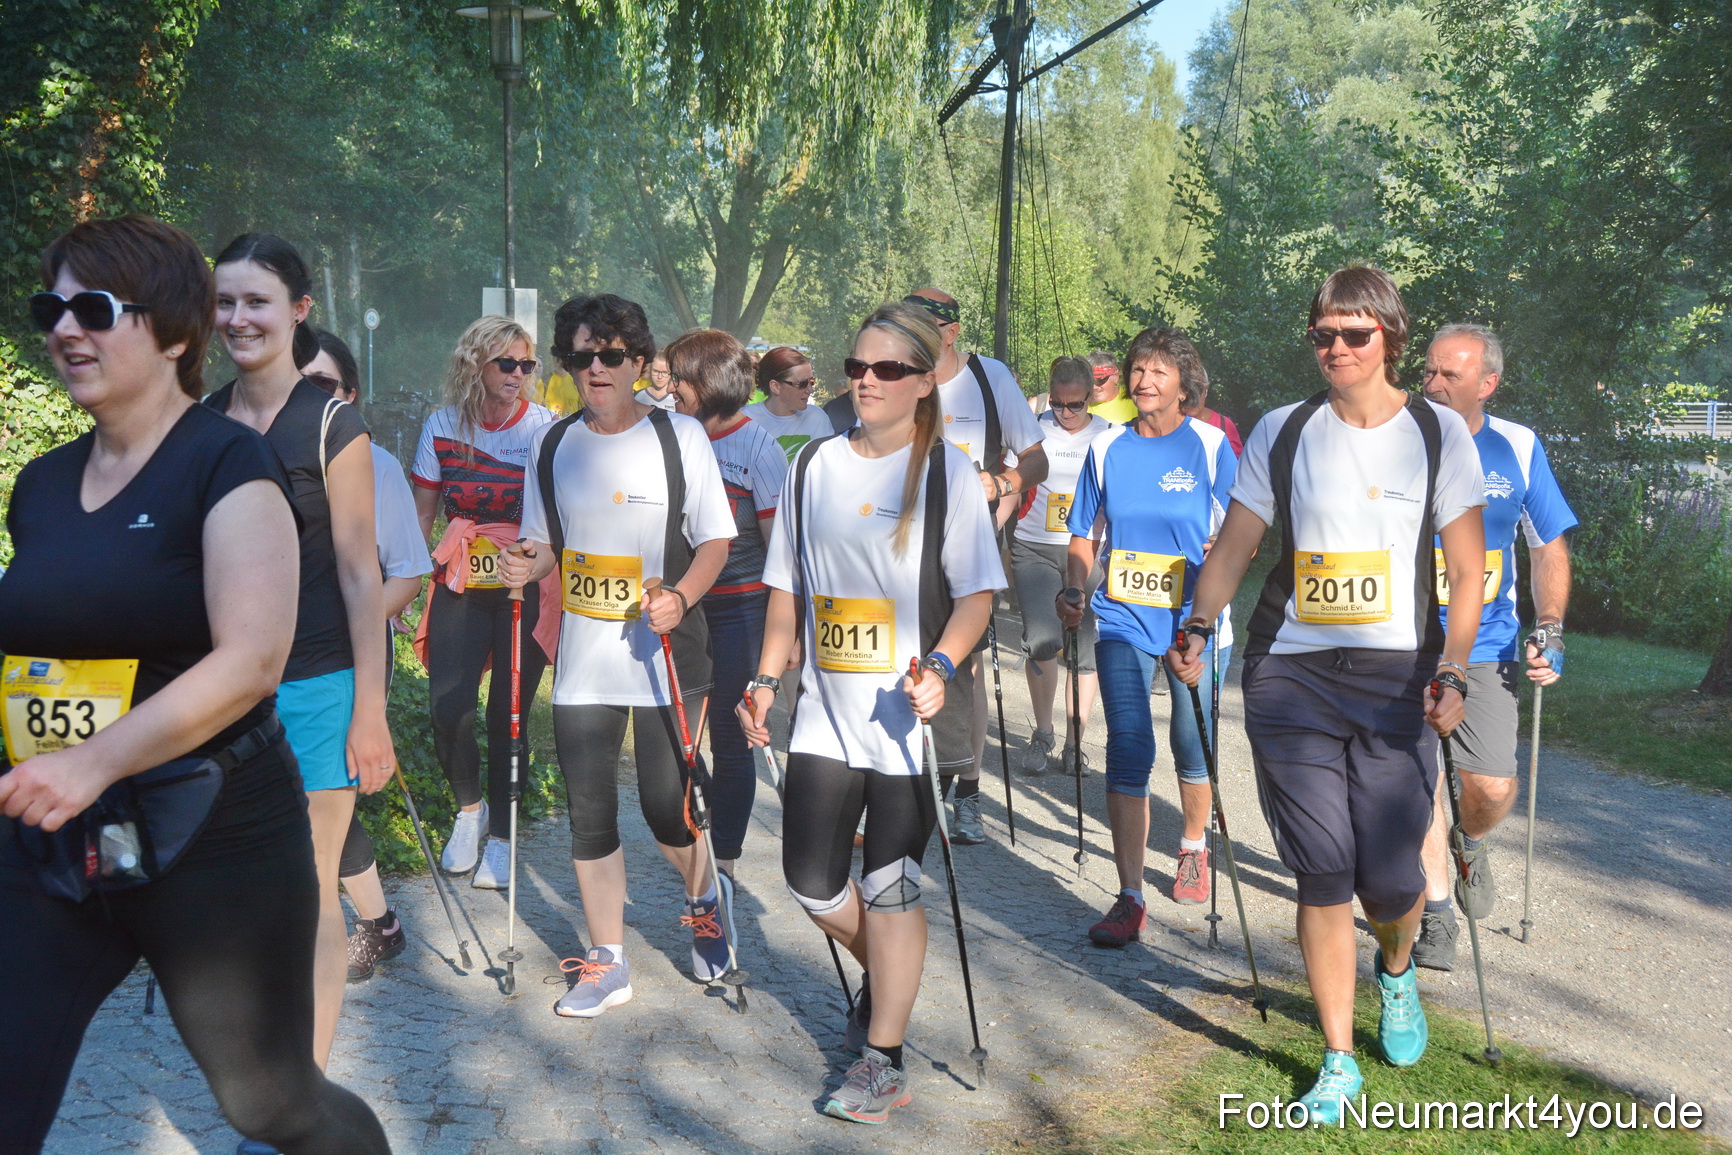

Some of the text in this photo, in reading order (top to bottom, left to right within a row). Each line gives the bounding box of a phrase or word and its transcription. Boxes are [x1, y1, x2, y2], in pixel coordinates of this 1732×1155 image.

[499, 447, 528, 456] NEUMAR
[1055, 449, 1086, 460] intellito
[469, 554, 497, 574] 90
[570, 573, 630, 602] 2013
[1118, 569, 1174, 593] 1966
[1438, 569, 1494, 589] 17
[1305, 576, 1378, 604] 2010
[578, 598, 620, 609] Krauser Olga
[1320, 604, 1349, 612] Schmid
[820, 622, 878, 651] 2011
[825, 650, 873, 659] Weber Kristina
[27, 697, 96, 740] 853
